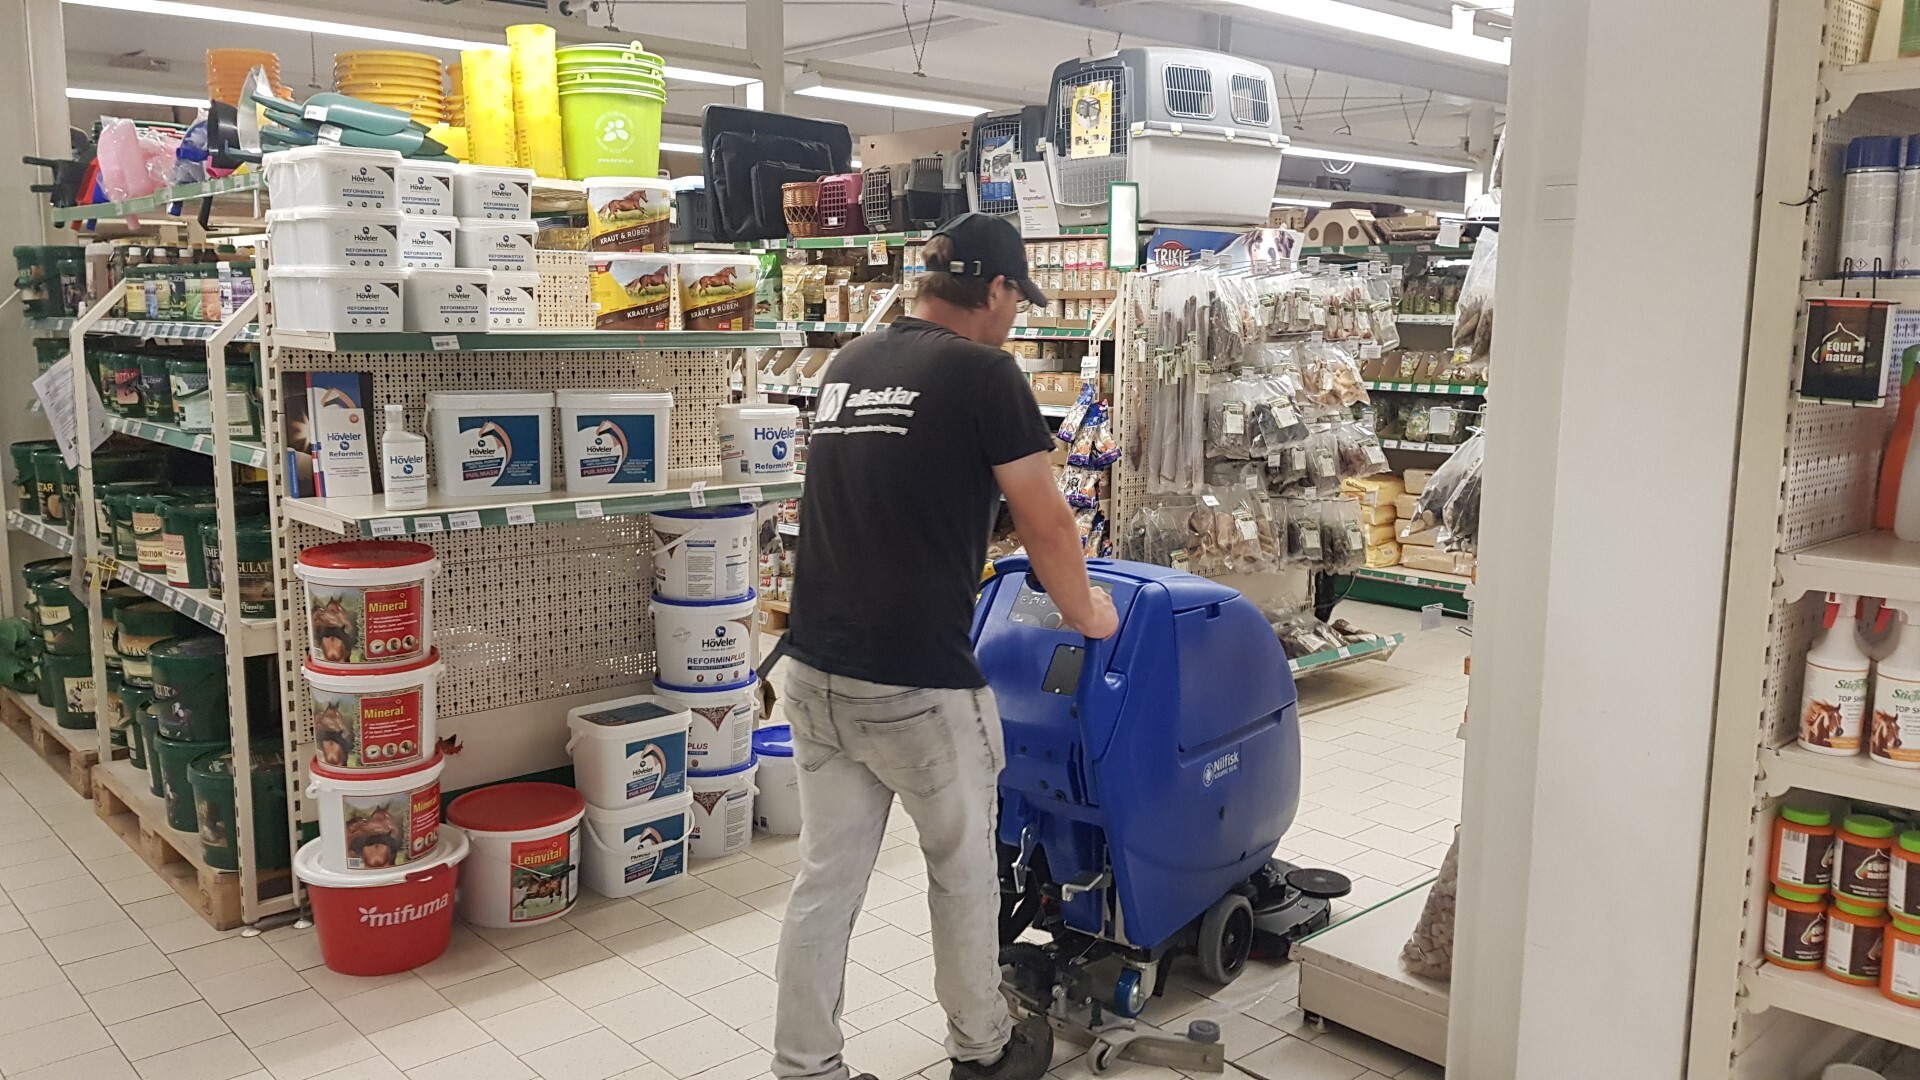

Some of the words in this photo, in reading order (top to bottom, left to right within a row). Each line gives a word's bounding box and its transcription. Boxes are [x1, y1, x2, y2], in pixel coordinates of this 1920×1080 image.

[600, 234, 619, 244] KRAUT
[627, 227, 650, 238] RÜBEN
[1153, 247, 1191, 266] TRIXIE
[627, 308, 650, 319] KRAUT
[690, 309, 710, 318] KRAUT
[717, 301, 739, 312] RÜBEN
[1826, 341, 1852, 352] EQUI
[1825, 353, 1864, 363] natura
[327, 432, 361, 442] Höveler
[329, 450, 363, 458] Reformin
[390, 455, 423, 465] Höveler
[368, 600, 407, 613] Mineral
[702, 638, 737, 648] Höveler
[687, 652, 746, 664] REFORMINPLUS
[364, 706, 404, 719] Mineral
[1895, 705, 1911, 713] TOP
[1213, 751, 1239, 773] Nilfisk
[413, 795, 437, 813] Mineral
[517, 847, 563, 866] Leinvital
[369, 893, 449, 927] mifuma
